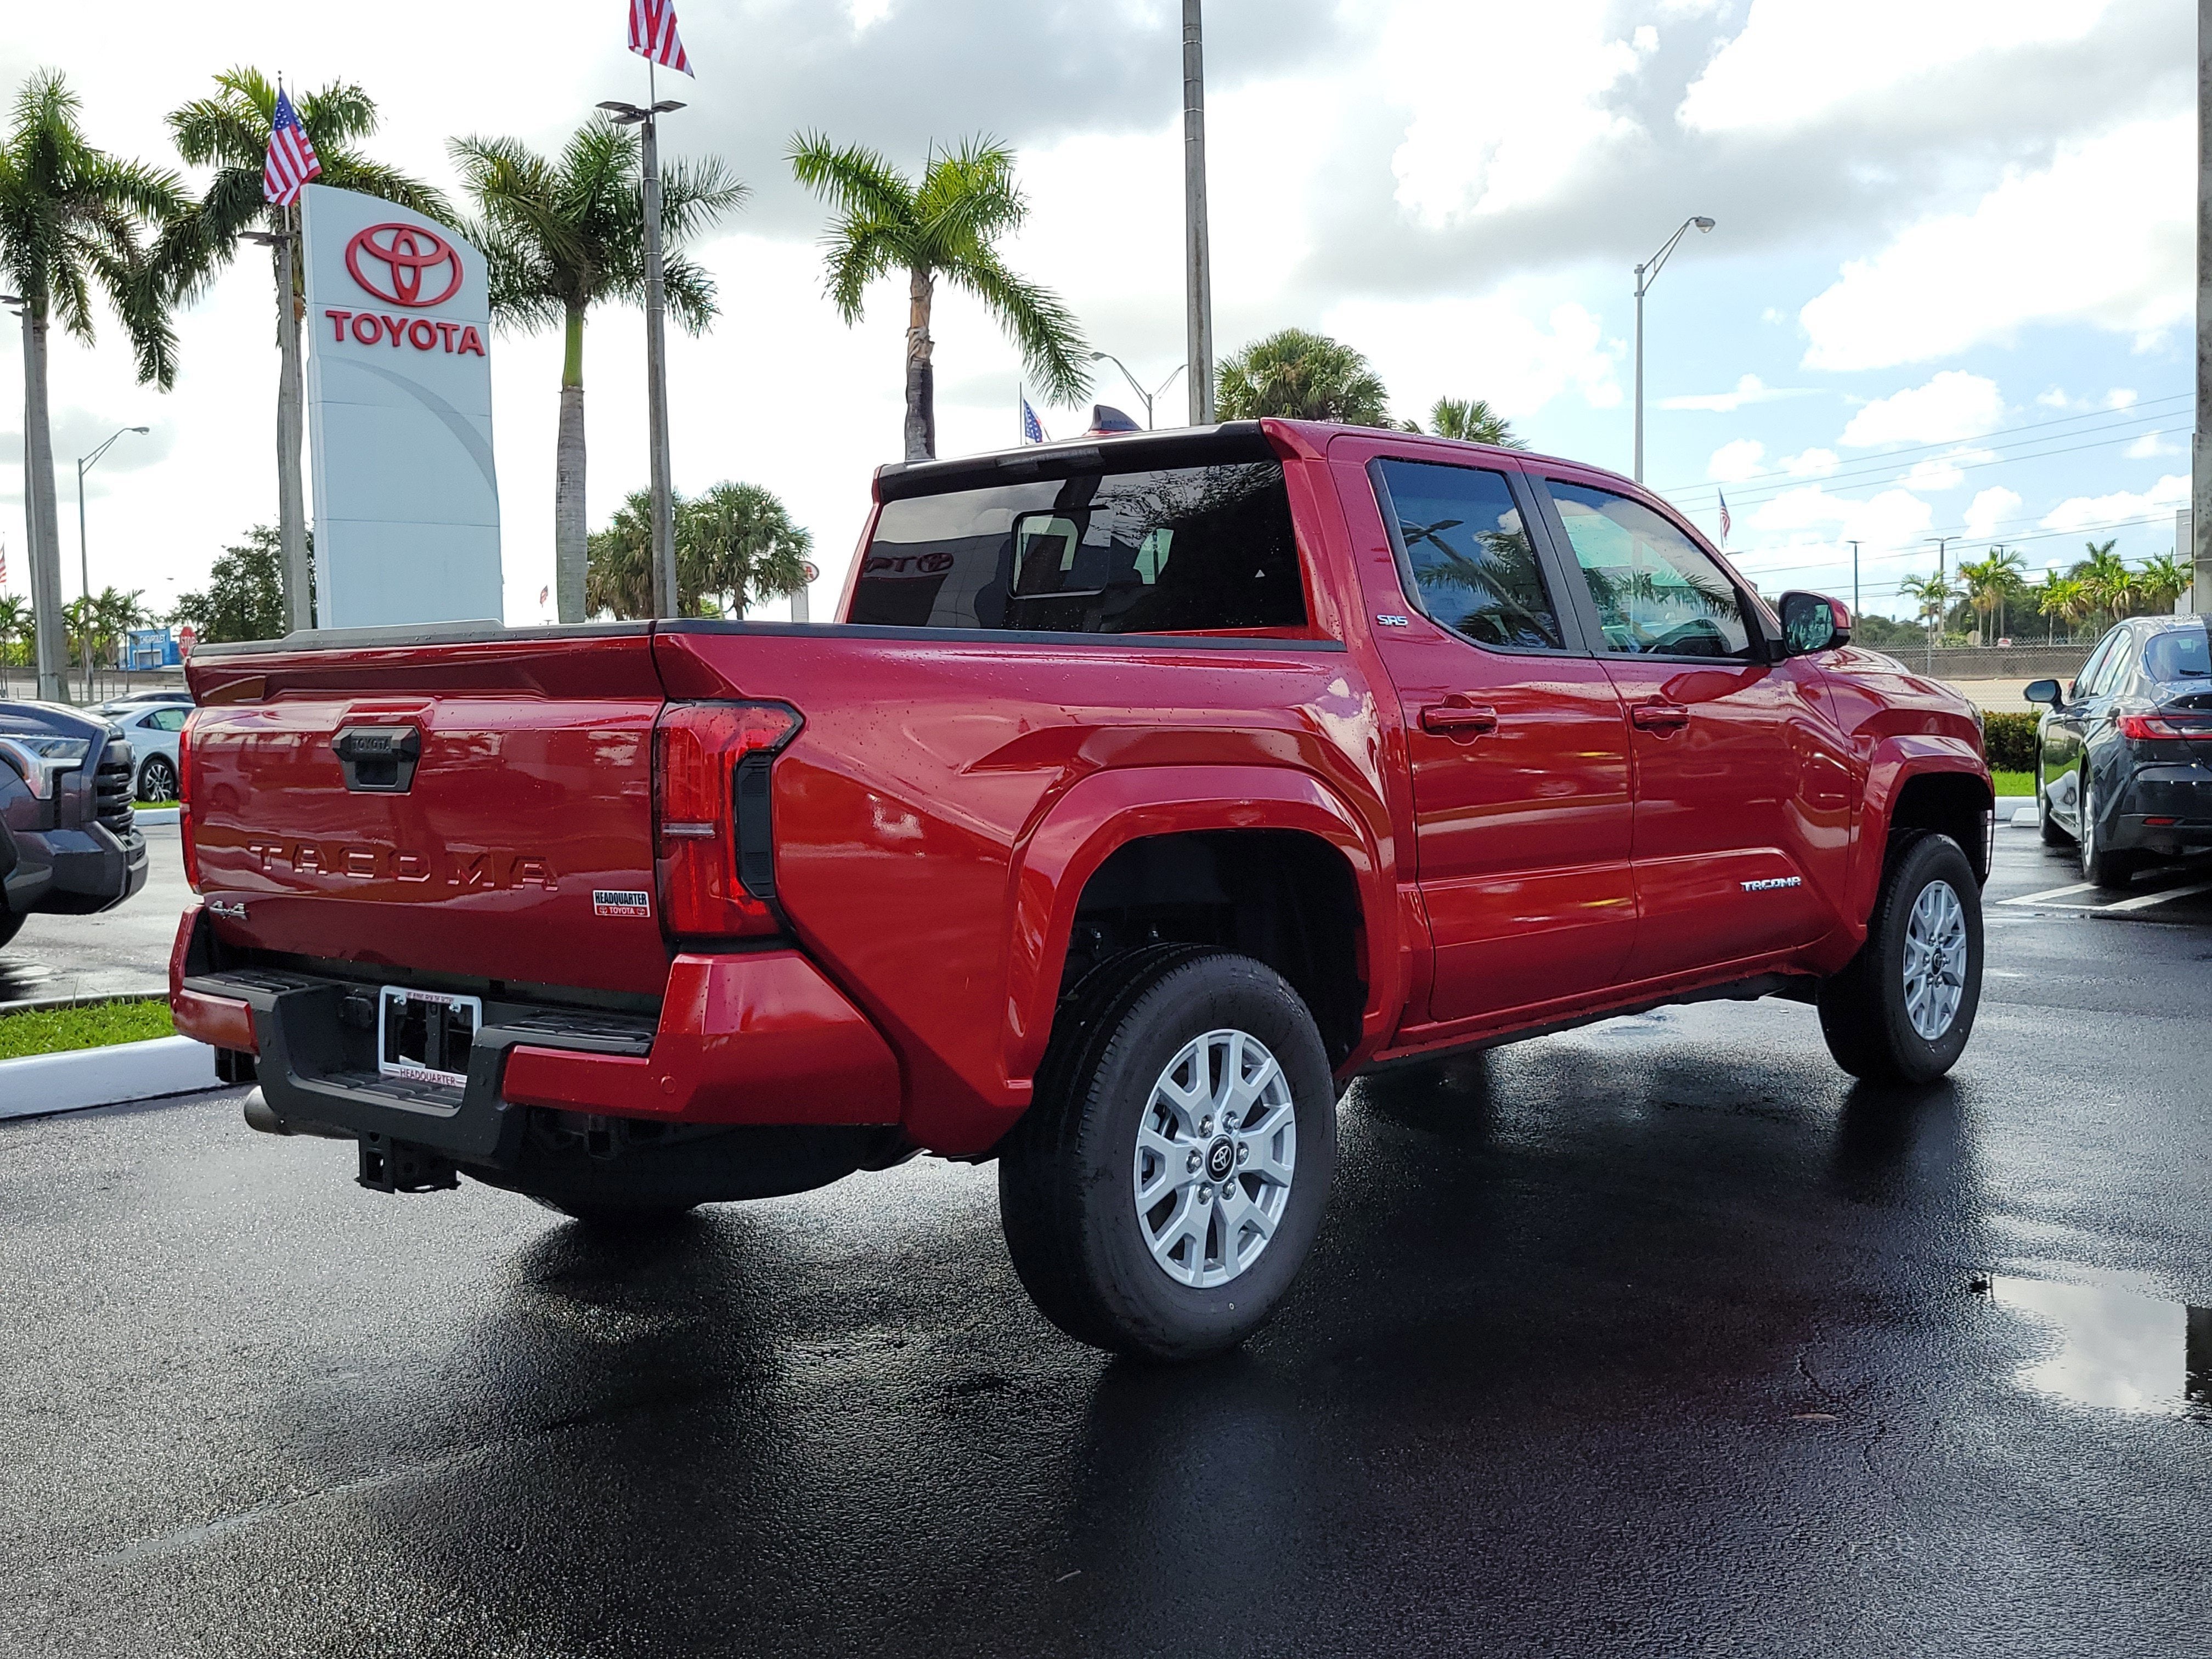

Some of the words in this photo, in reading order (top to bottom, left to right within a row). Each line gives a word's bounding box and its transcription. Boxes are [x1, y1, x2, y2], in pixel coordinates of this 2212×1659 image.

[326, 311, 486, 356] TOYOTA
[1376, 614, 1408, 626] SR5
[352, 737, 392, 752] TOYOTA
[247, 839, 558, 891] TACOMA
[1740, 876, 1801, 891] TACOMA
[595, 891, 647, 905] HEADQUARTER
[609, 906, 635, 915] TOYOTA
[400, 1068, 456, 1085] HEADQUARTER
